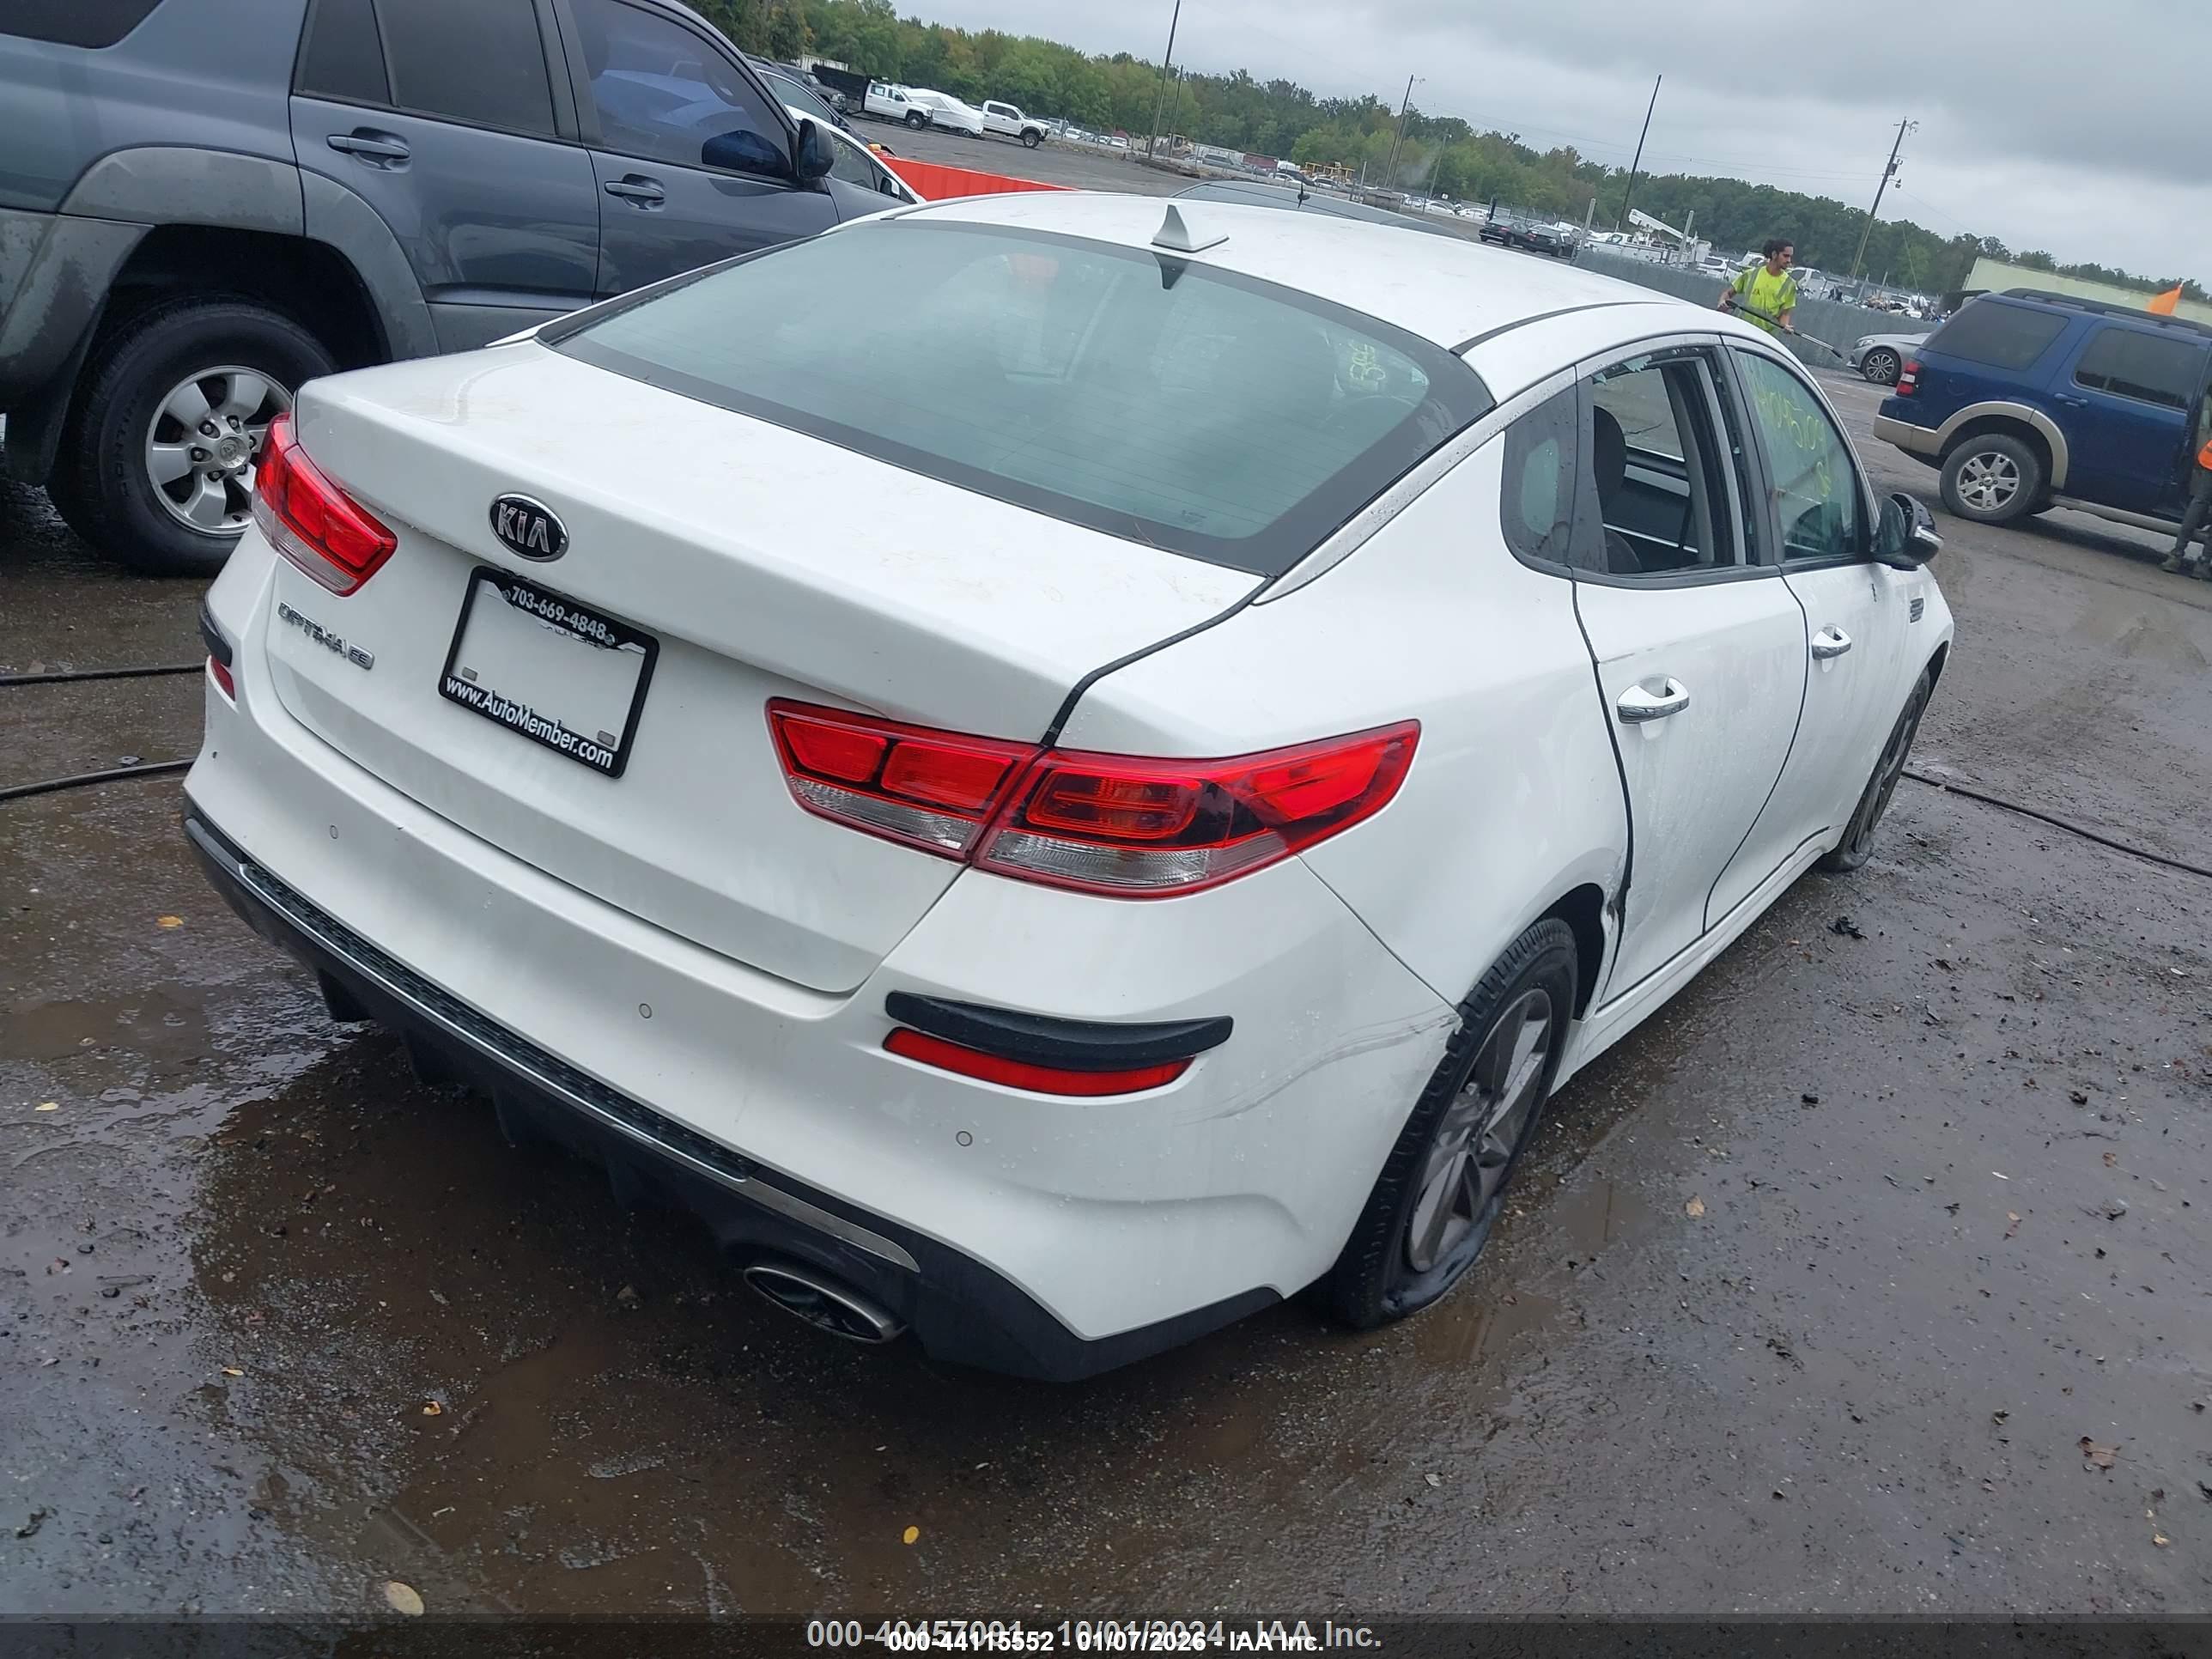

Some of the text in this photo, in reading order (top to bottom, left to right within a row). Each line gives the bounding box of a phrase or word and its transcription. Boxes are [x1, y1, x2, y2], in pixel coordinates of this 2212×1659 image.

[497, 501, 550, 554] KIA
[277, 601, 348, 659] OPTIMA
[511, 585, 607, 641] 703-669-4848
[445, 676, 615, 769] www.AutoMember.com
